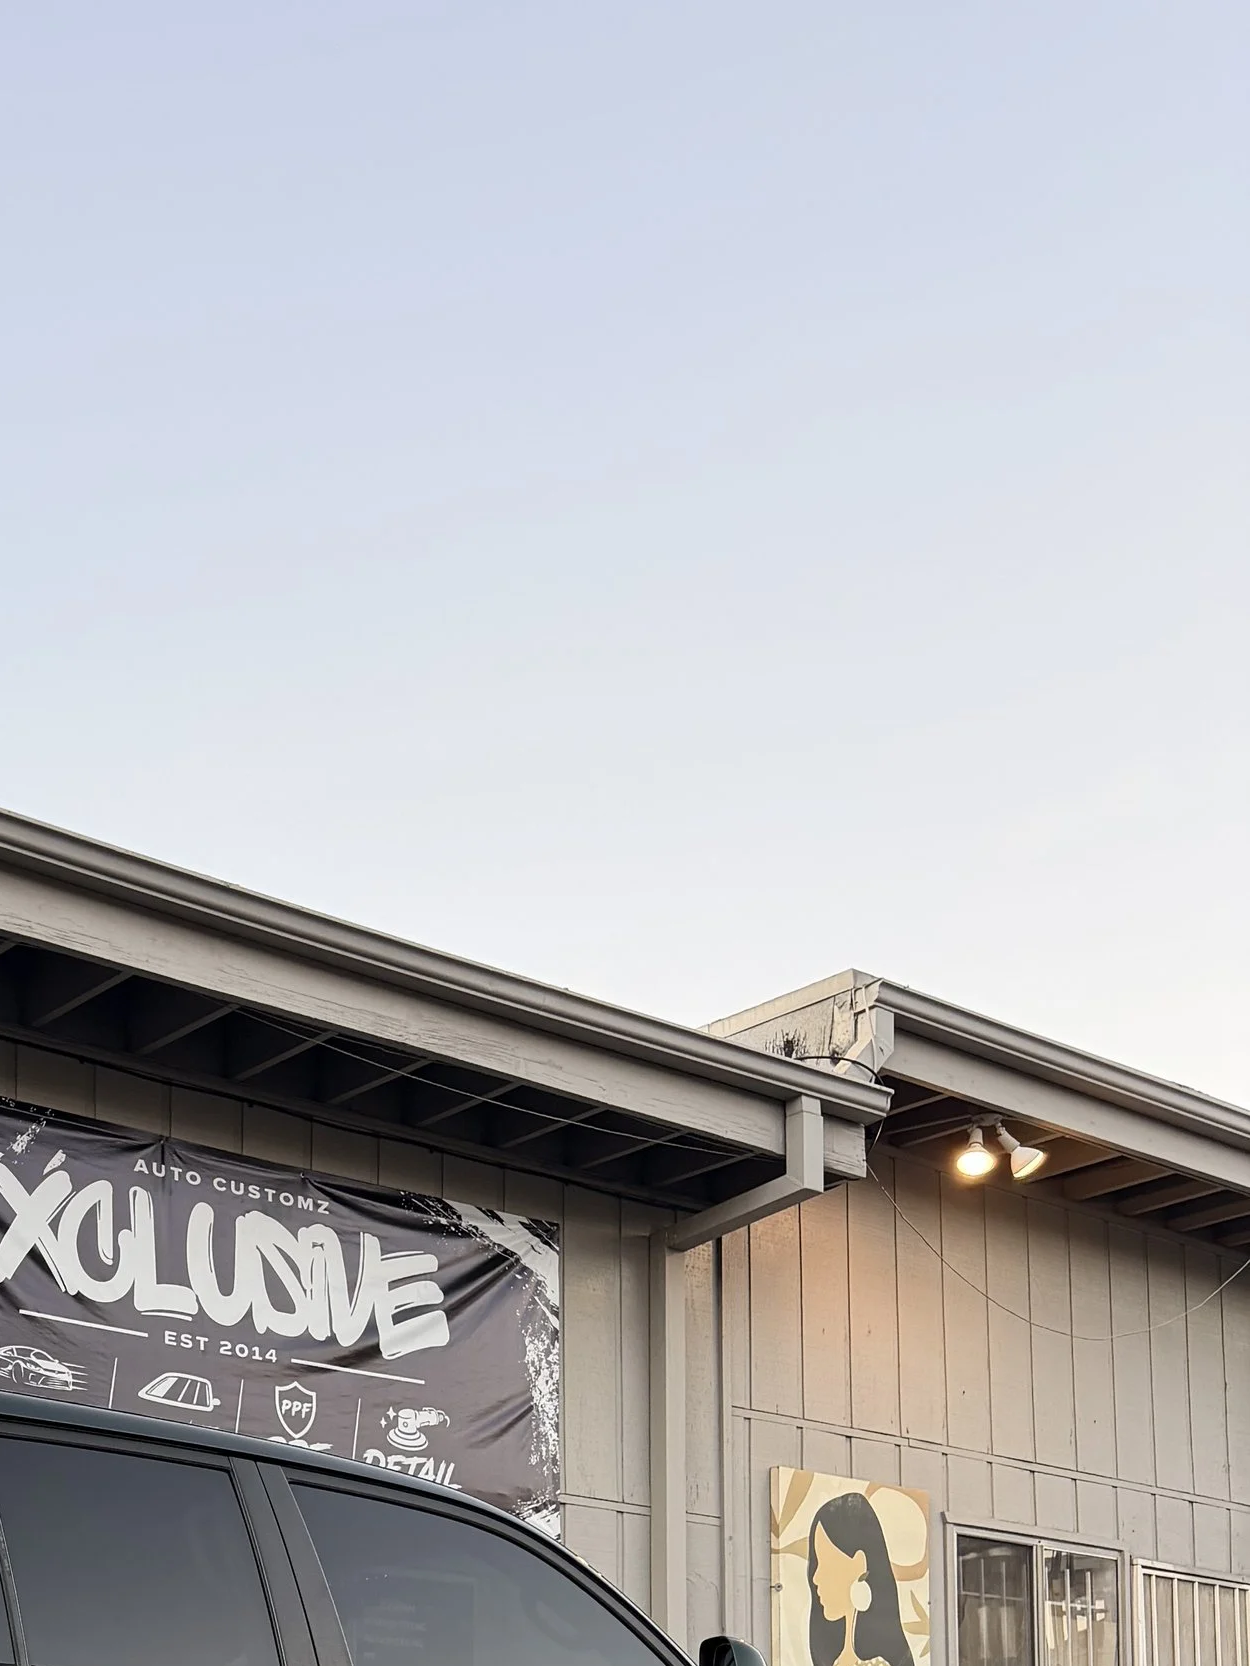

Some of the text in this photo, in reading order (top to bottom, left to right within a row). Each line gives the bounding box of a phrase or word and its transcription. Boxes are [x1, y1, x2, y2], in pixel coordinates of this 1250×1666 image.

[133, 1158, 331, 1216] AUTO CUSTOMZ
[164, 1329, 278, 1363] EST 2014
[281, 1399, 313, 1419] PPF
[362, 1448, 463, 1490] DETAIL
